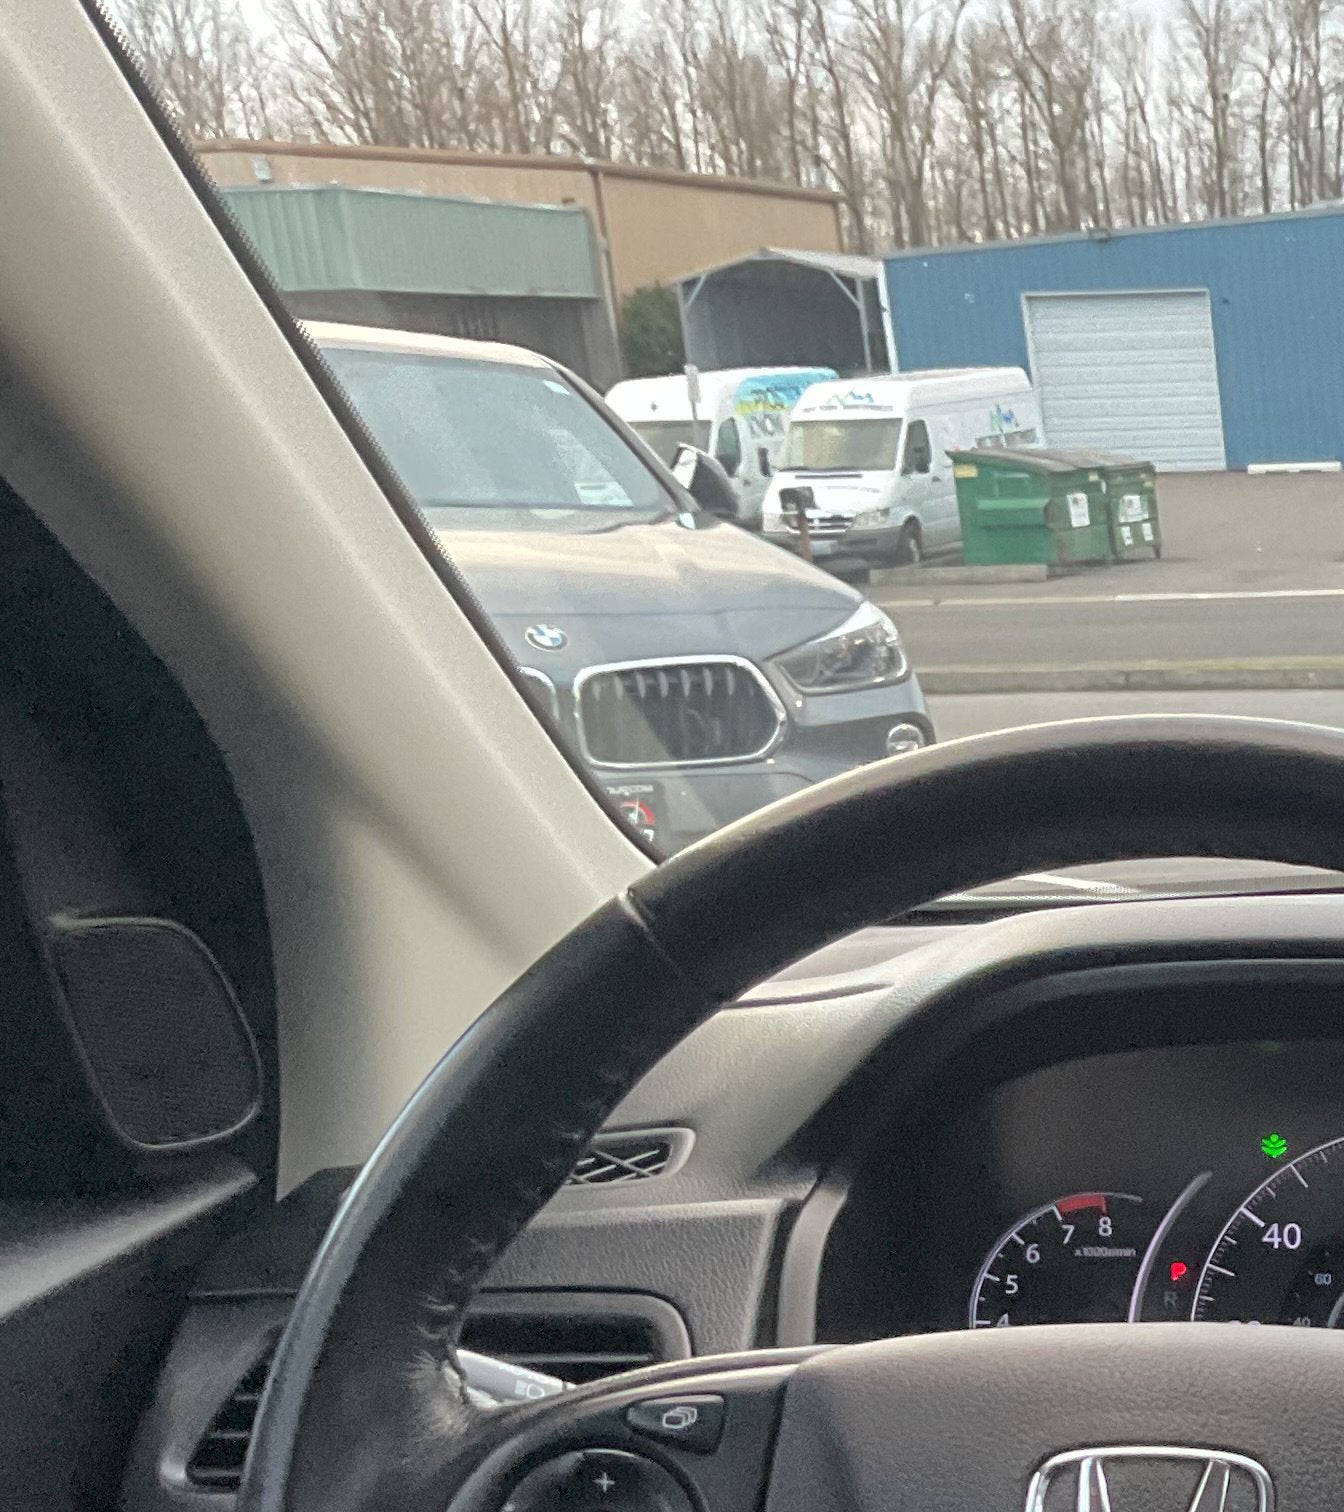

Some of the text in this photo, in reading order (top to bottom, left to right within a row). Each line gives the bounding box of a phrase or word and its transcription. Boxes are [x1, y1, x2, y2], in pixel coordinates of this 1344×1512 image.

[1061, 1223, 1076, 1244] 7
[1098, 1216, 1113, 1237] 8
[1261, 1222, 1302, 1250] 40
[1025, 1243, 1041, 1264] 6
[1169, 1261, 1187, 1281] P
[1313, 1272, 1332, 1286] 60
[1004, 1274, 1019, 1295] 5
